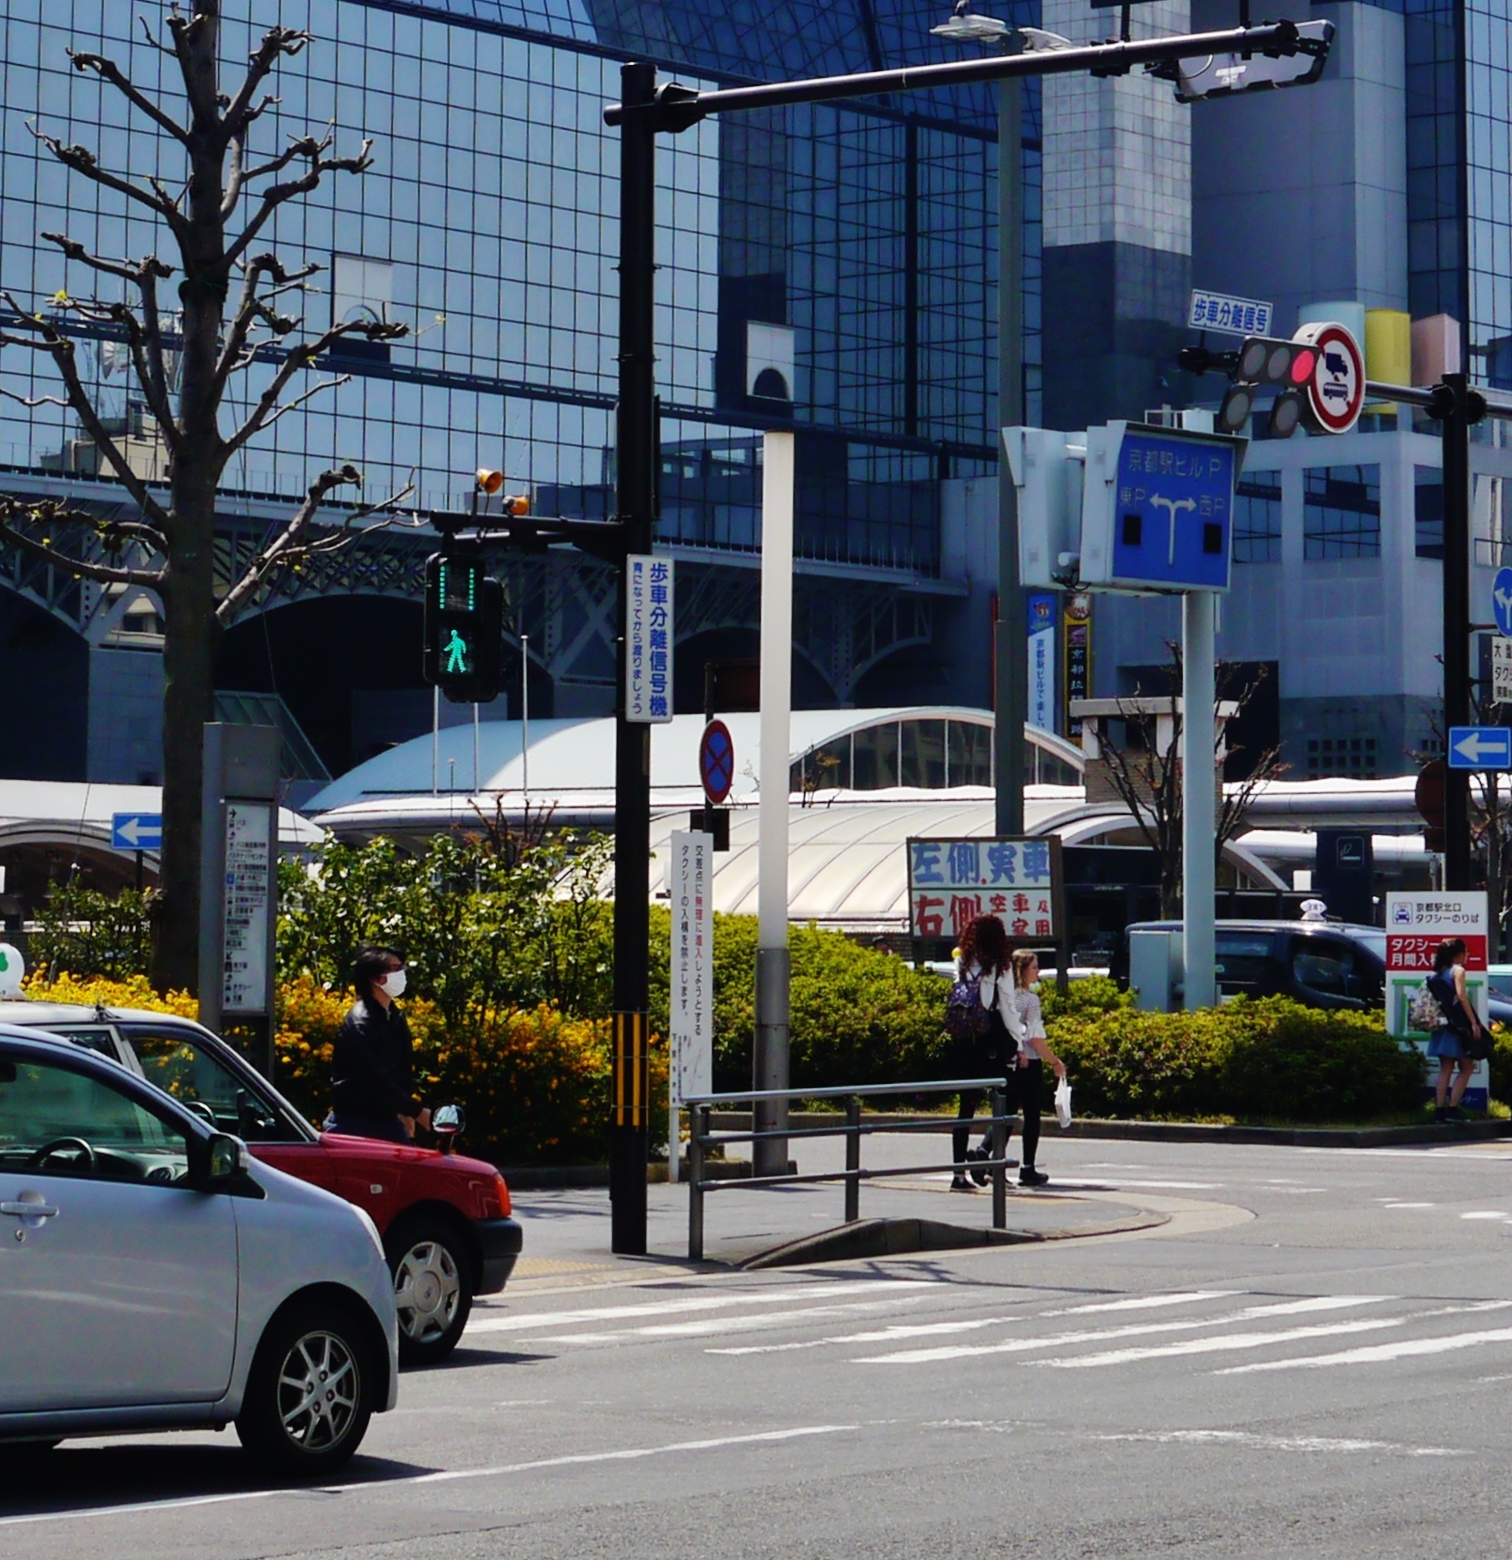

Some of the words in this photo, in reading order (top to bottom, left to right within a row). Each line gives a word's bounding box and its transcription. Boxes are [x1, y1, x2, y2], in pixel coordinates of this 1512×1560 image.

[1194, 298, 1267, 333] 歩車分離信号
[1128, 449, 1203, 477] 京都駅ビル
[632, 562, 643, 714] 青になってから渡りましょう
[649, 562, 668, 717] 歩車分離信号機
[1415, 914, 1480, 924] タクシーのりば
[1416, 902, 1462, 912] 京都駅北口
